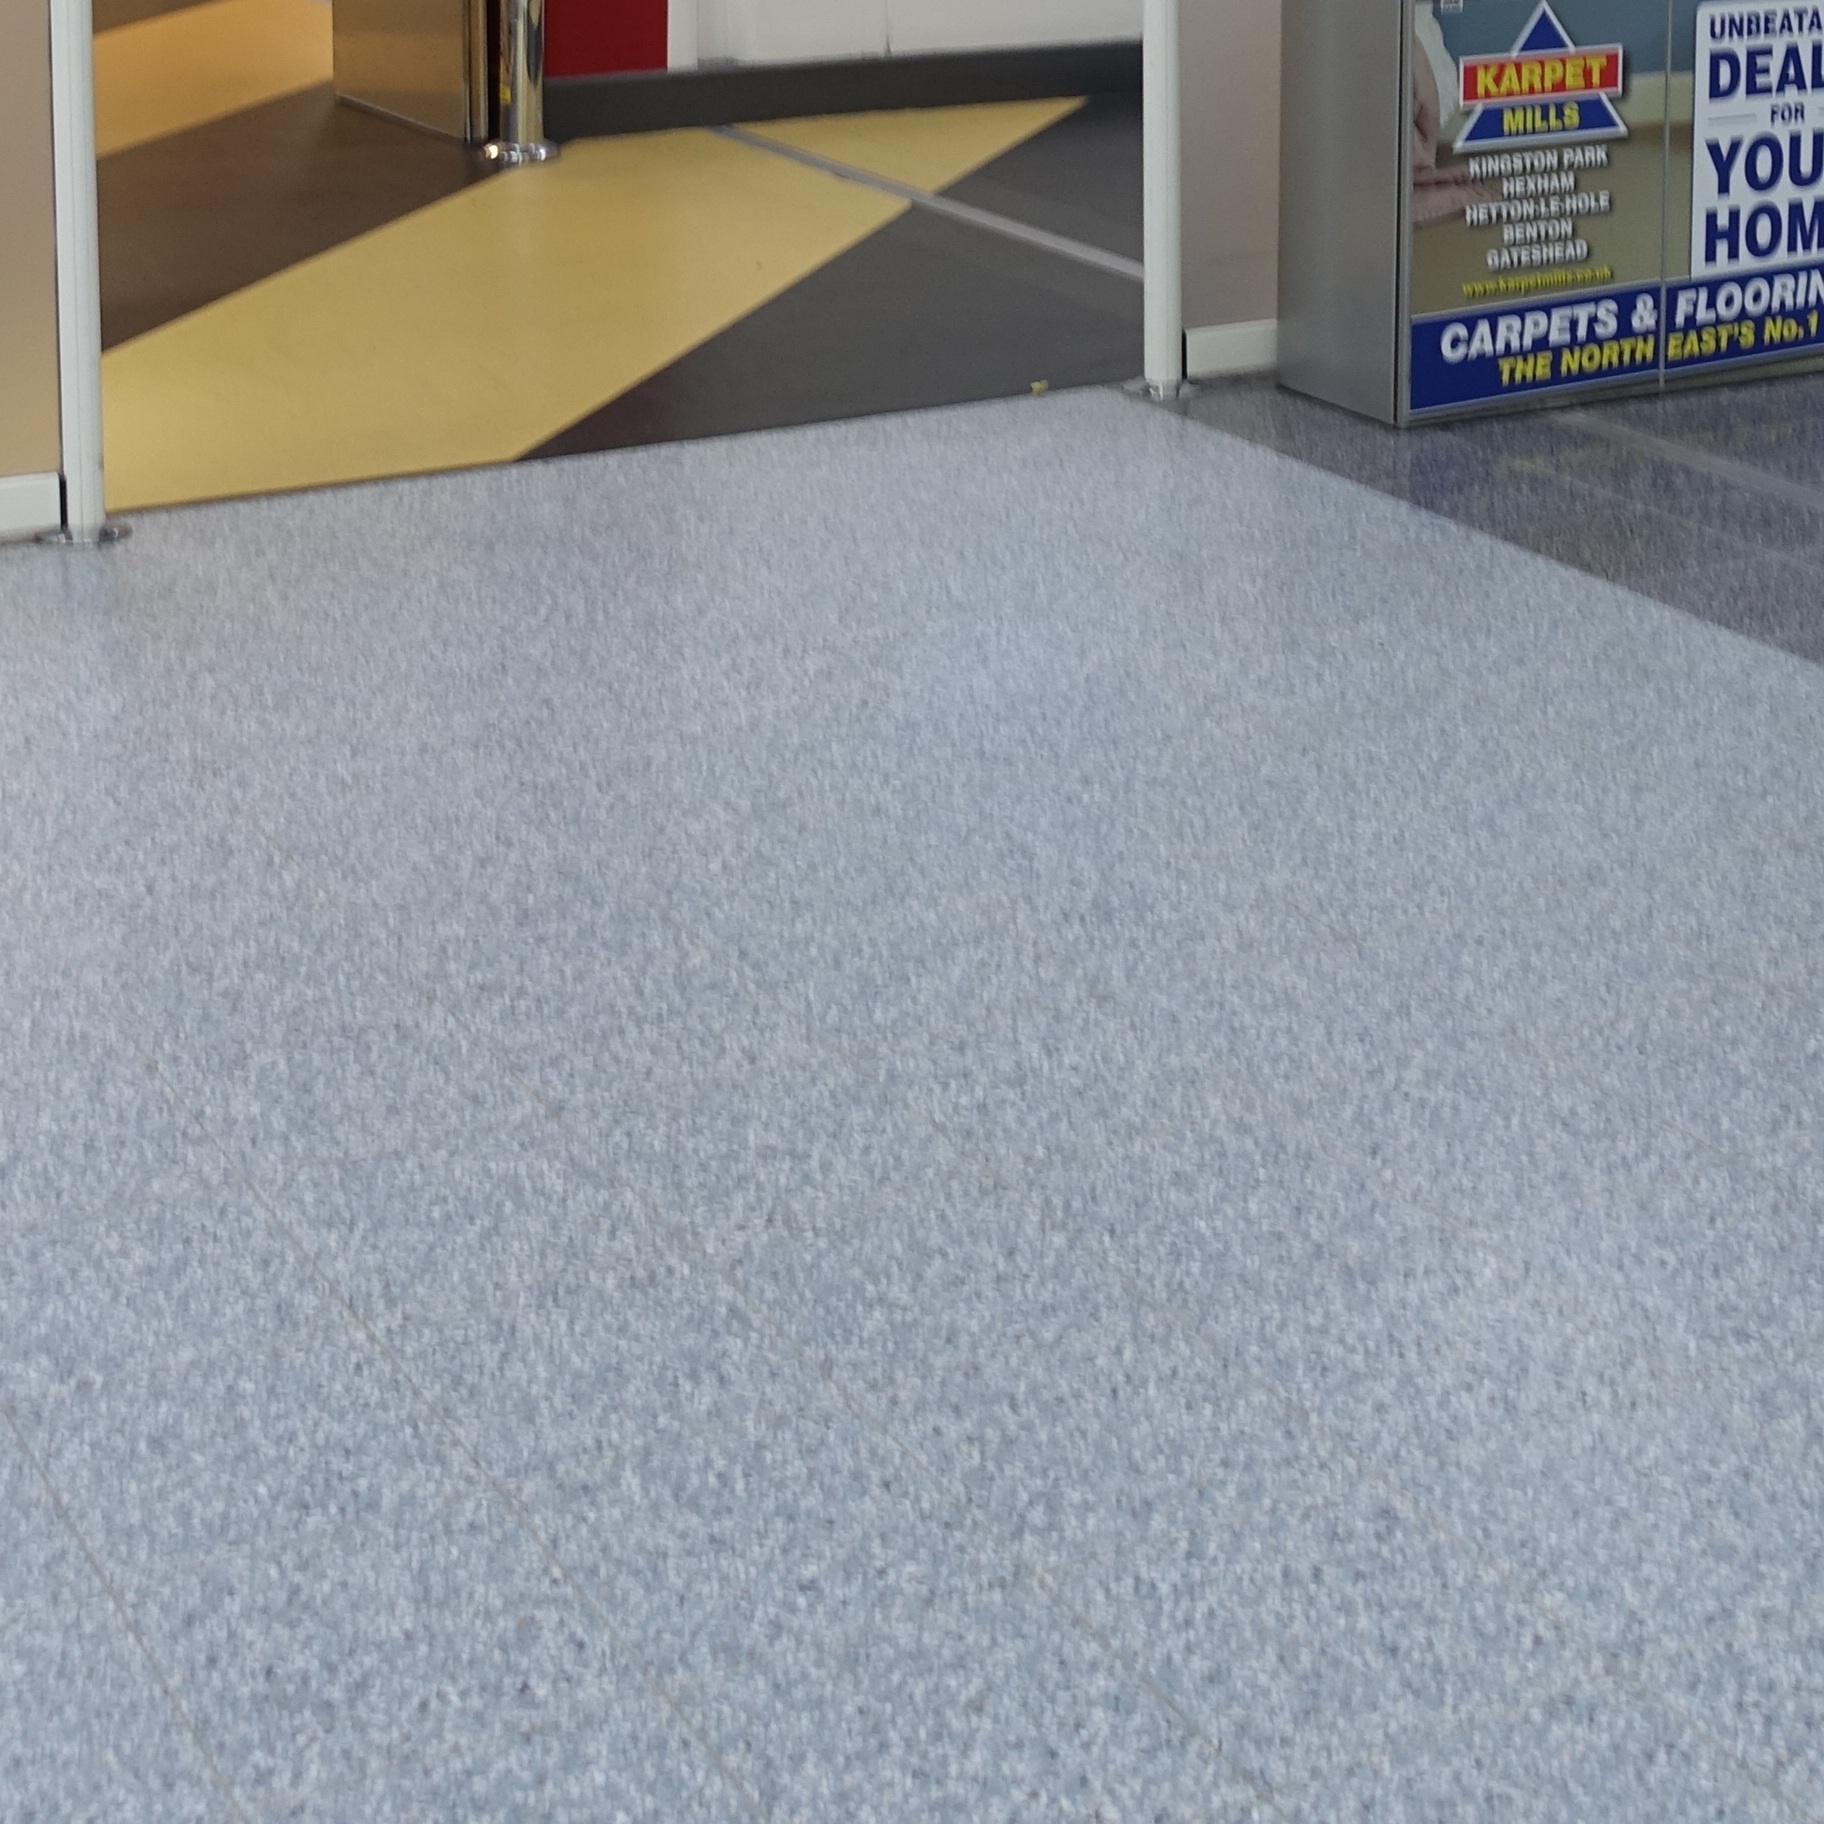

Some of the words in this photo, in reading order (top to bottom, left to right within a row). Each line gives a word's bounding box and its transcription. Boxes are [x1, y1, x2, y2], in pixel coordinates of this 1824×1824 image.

[1477, 55, 1607, 98] KARPET
[1503, 101, 1580, 136] MILLS
[1770, 101, 1805, 125] FOR
[1469, 149, 1558, 179] KINGSTON
[1563, 144, 1609, 170] PARK
[1502, 171, 1576, 198] HEXHAM
[1504, 217, 1573, 245] BENTON
[1487, 239, 1589, 271] GATESHEAD
[1440, 298, 1618, 364] CARPETS
[1631, 292, 1657, 333] &
[1499, 350, 1553, 387] THE
[1560, 334, 1655, 376] NORTH
[1667, 319, 1755, 361] EAST'S
